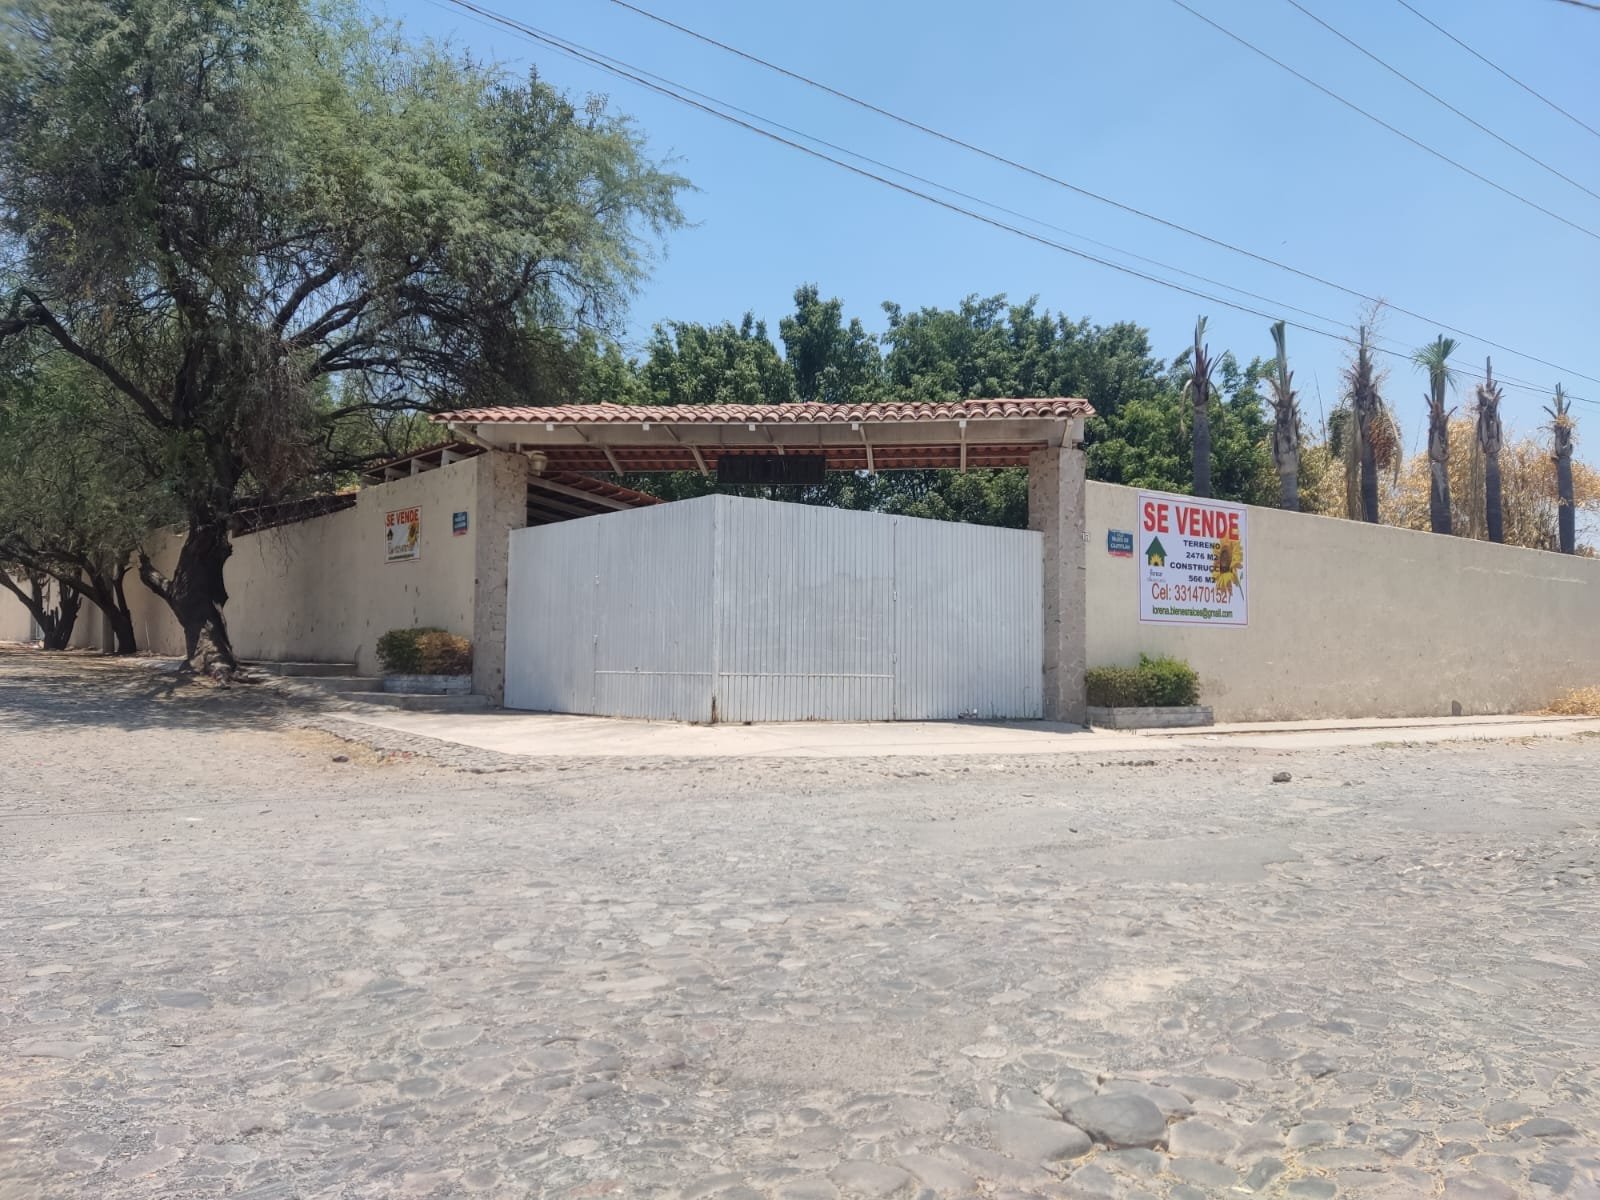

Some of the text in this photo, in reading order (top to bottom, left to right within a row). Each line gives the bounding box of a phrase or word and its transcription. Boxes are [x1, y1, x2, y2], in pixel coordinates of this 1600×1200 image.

[386, 508, 419, 527] SE VENDE
[1144, 502, 1240, 540] SE VENDE
[1183, 540, 1221, 550] TERRENO
[1186, 551, 1219, 561] 2476 M2
[1188, 575, 1217, 584] 566 M2
[1151, 582, 1172, 601] Cel:
